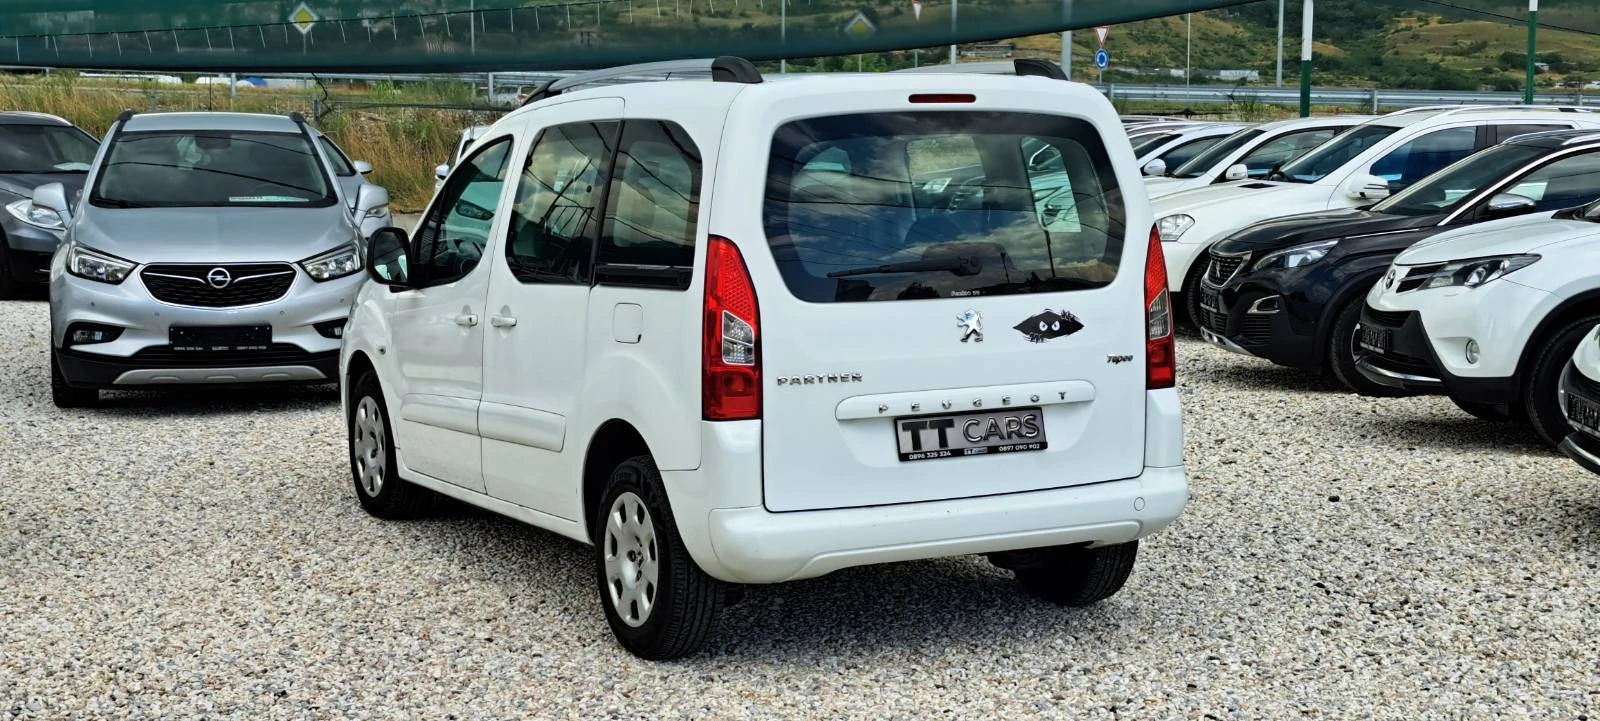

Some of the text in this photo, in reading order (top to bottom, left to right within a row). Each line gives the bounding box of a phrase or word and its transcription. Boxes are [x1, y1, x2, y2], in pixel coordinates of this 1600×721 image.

[777, 373, 863, 386] PARTNER
[878, 391, 1067, 414] PEUGEOT
[901, 413, 1041, 451] TT CARS
